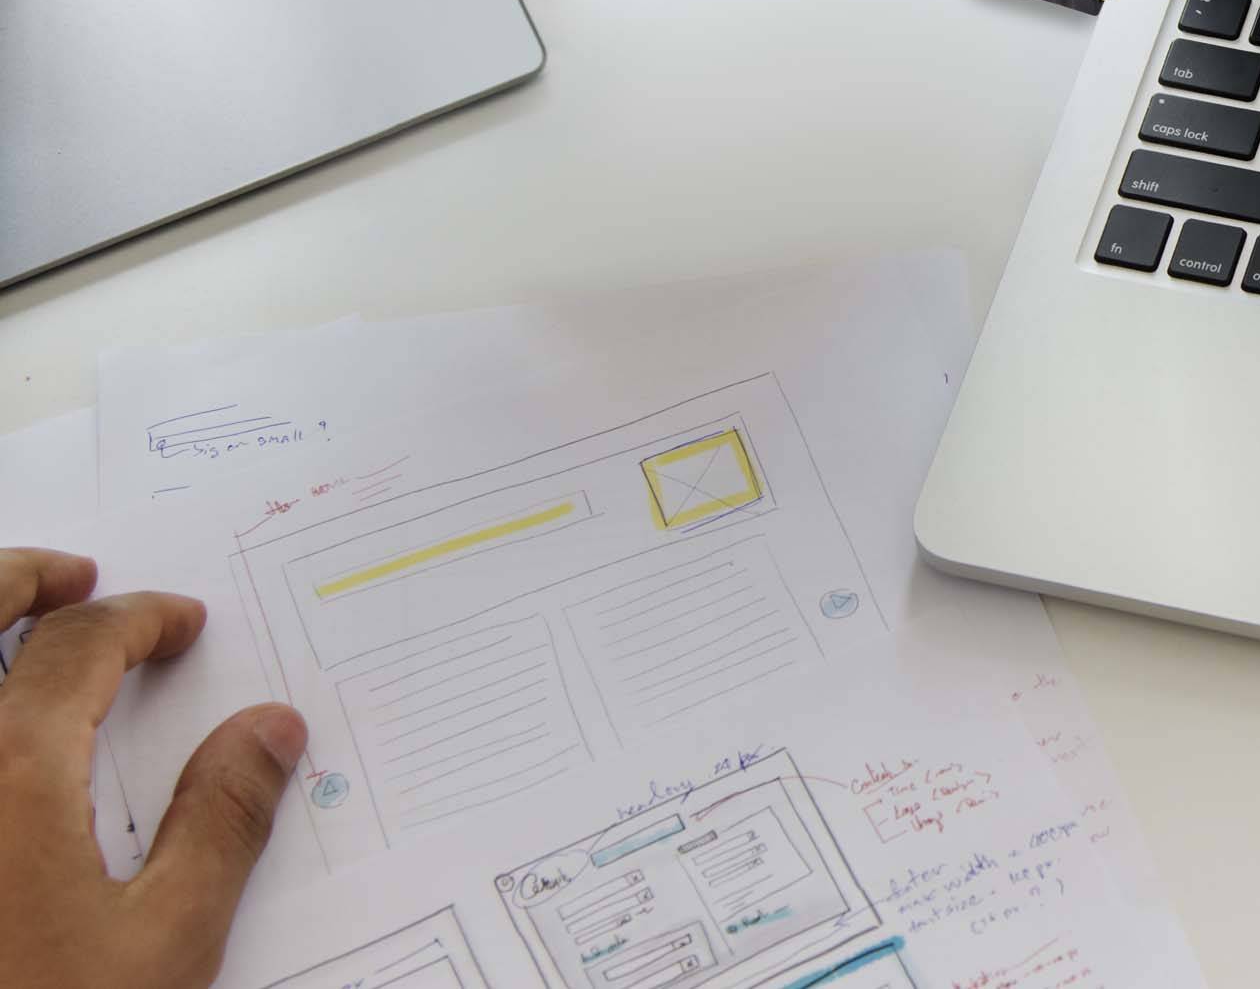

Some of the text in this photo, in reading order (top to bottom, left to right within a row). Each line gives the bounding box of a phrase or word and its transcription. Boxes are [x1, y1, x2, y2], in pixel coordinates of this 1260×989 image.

[1173, 67, 1193, 79] tab
[1153, 124, 1208, 141] caps lock
[1131, 180, 1159, 192] shift
[1110, 243, 1122, 254] fn
[1179, 259, 1222, 273] control
